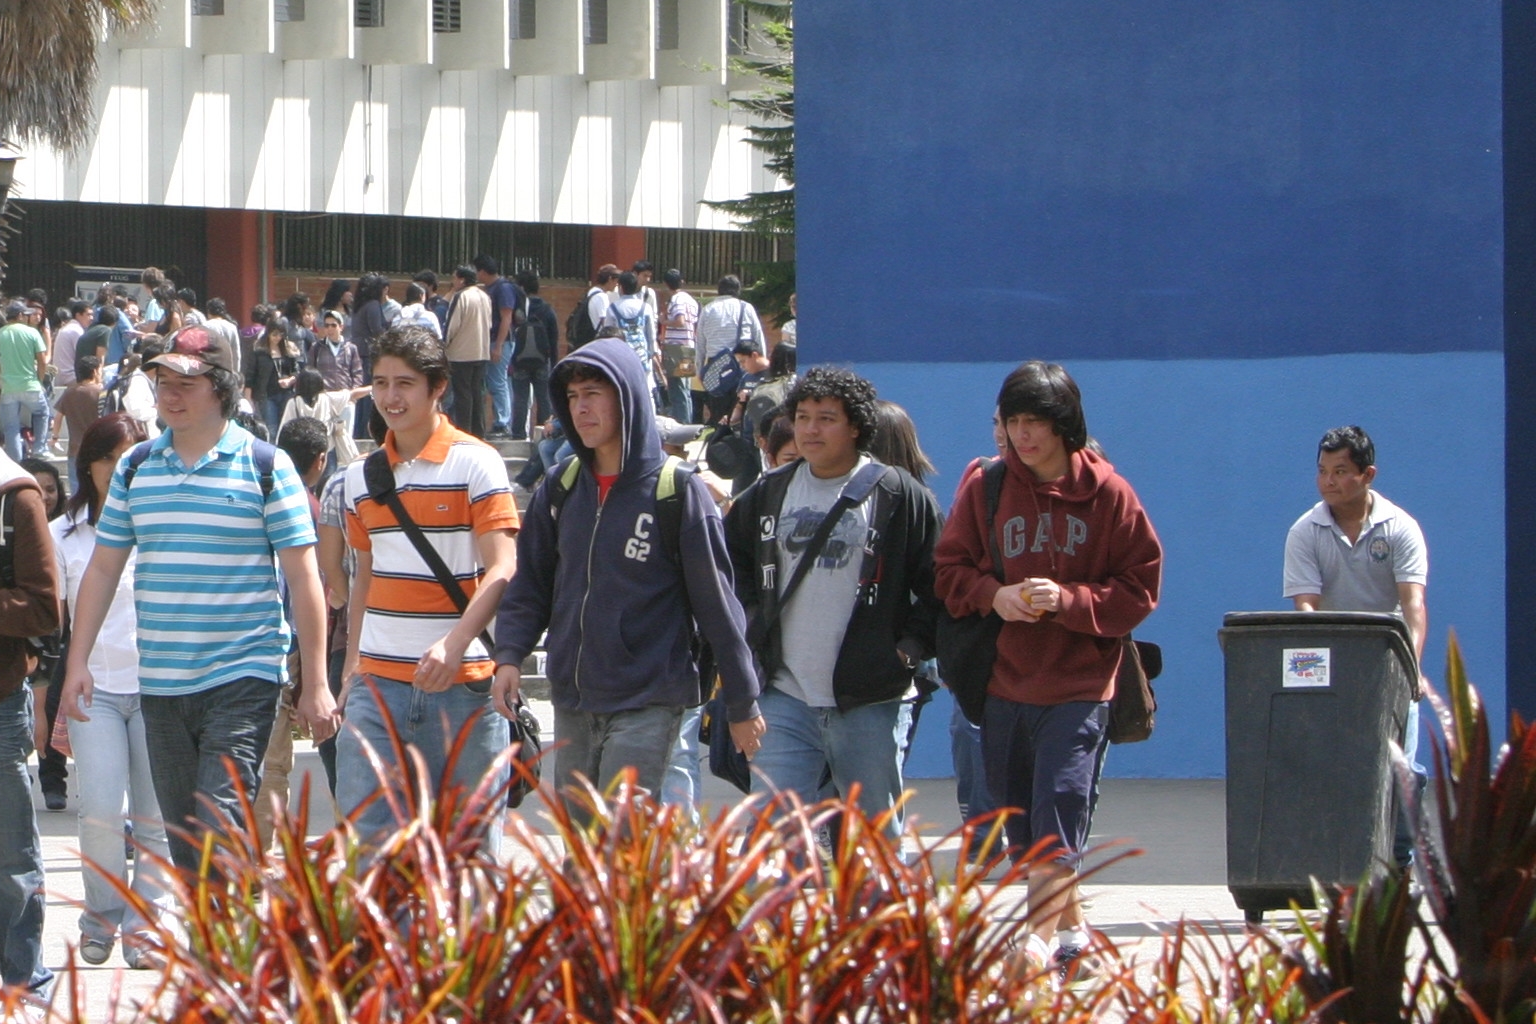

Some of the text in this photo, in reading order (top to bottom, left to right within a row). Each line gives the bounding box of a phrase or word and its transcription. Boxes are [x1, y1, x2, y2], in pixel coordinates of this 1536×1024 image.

[635, 512, 654, 540] C
[1003, 512, 1088, 559] GAP
[624, 537, 651, 562] 62
